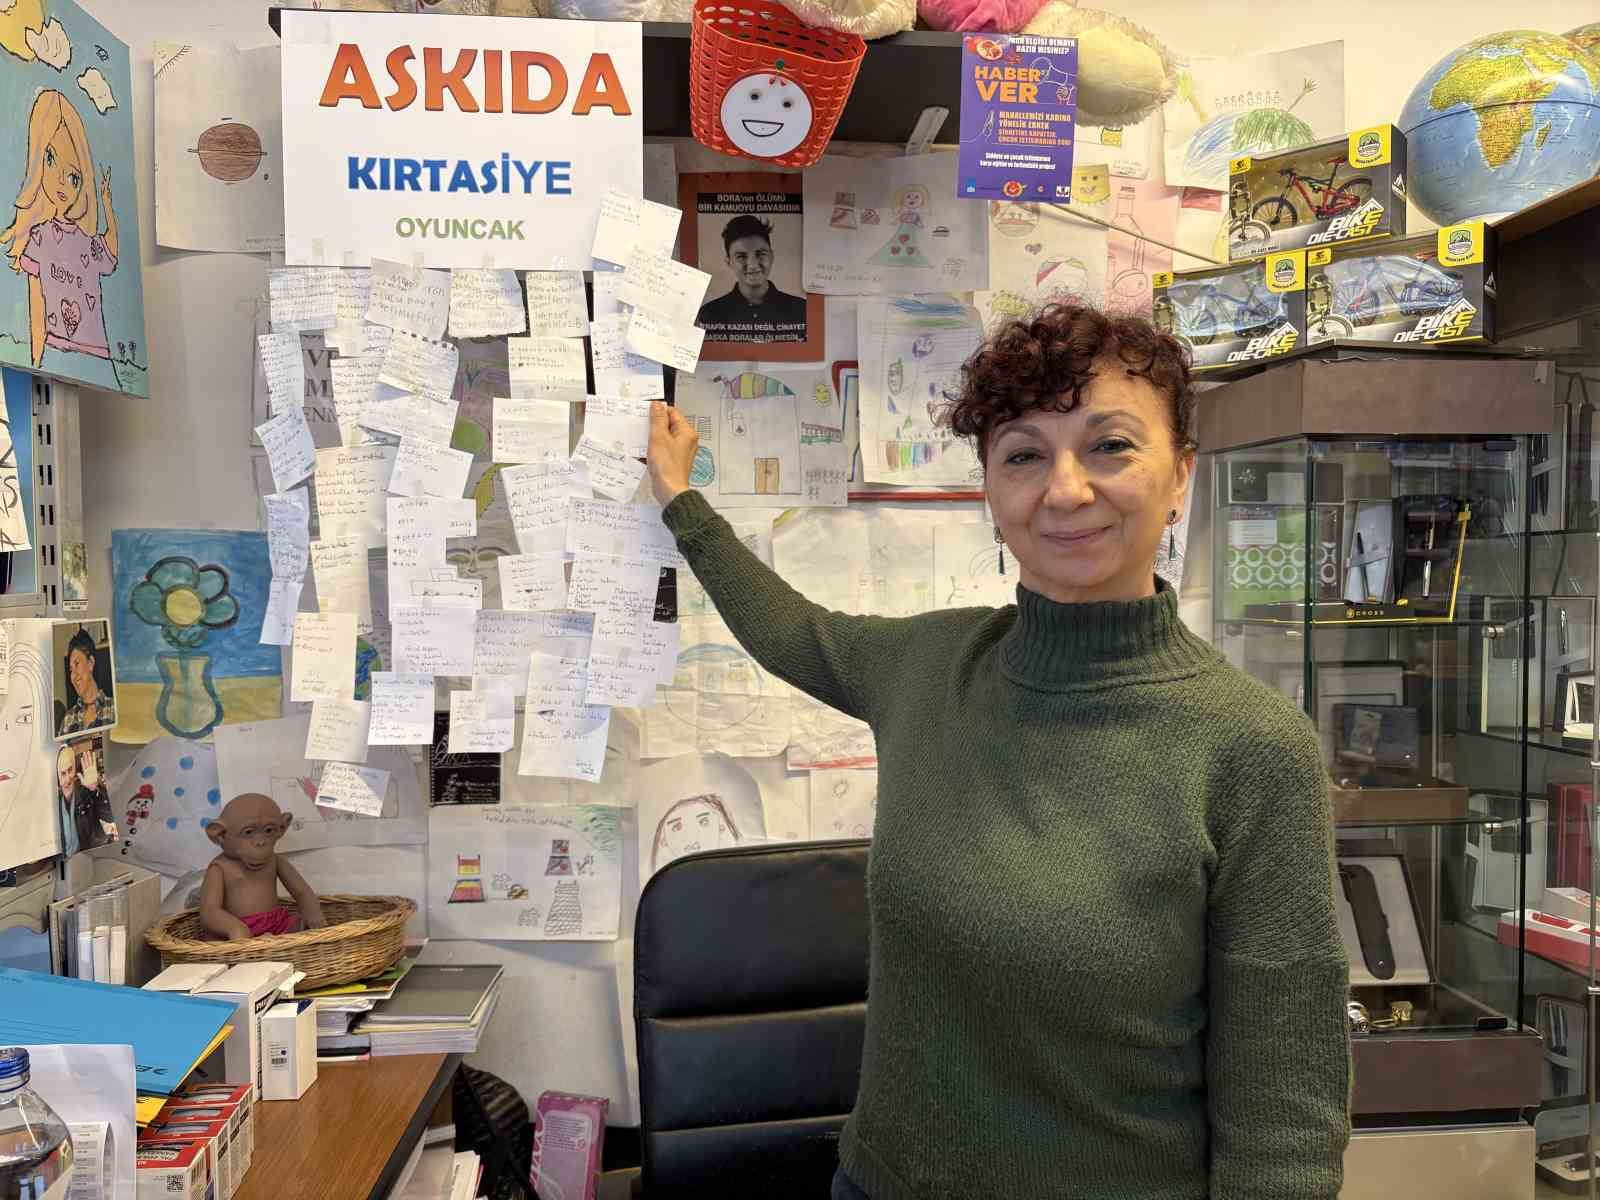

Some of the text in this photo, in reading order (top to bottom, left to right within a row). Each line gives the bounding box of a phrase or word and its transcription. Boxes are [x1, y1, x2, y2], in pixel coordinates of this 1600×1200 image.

[318, 43, 632, 116] ASKIDA
[975, 65, 1042, 82] HABER
[975, 80, 1039, 104] VER
[347, 152, 572, 195] KIRTASİYE
[697, 203, 713, 212] BİR
[714, 203, 756, 213] KAMUOYU
[1328, 207, 1384, 232] BIKE
[395, 217, 525, 241] OYUNCAK
[1307, 223, 1377, 246] DIE-CAST
[728, 323, 754, 331] KAZASI
[755, 322, 776, 332] DEĞİL
[1415, 307, 1477, 334] BIKE
[1246, 331, 1297, 352] BIKE
[1393, 325, 1465, 343] DIE-CAST
[1227, 345, 1291, 362] DIE-CAST
